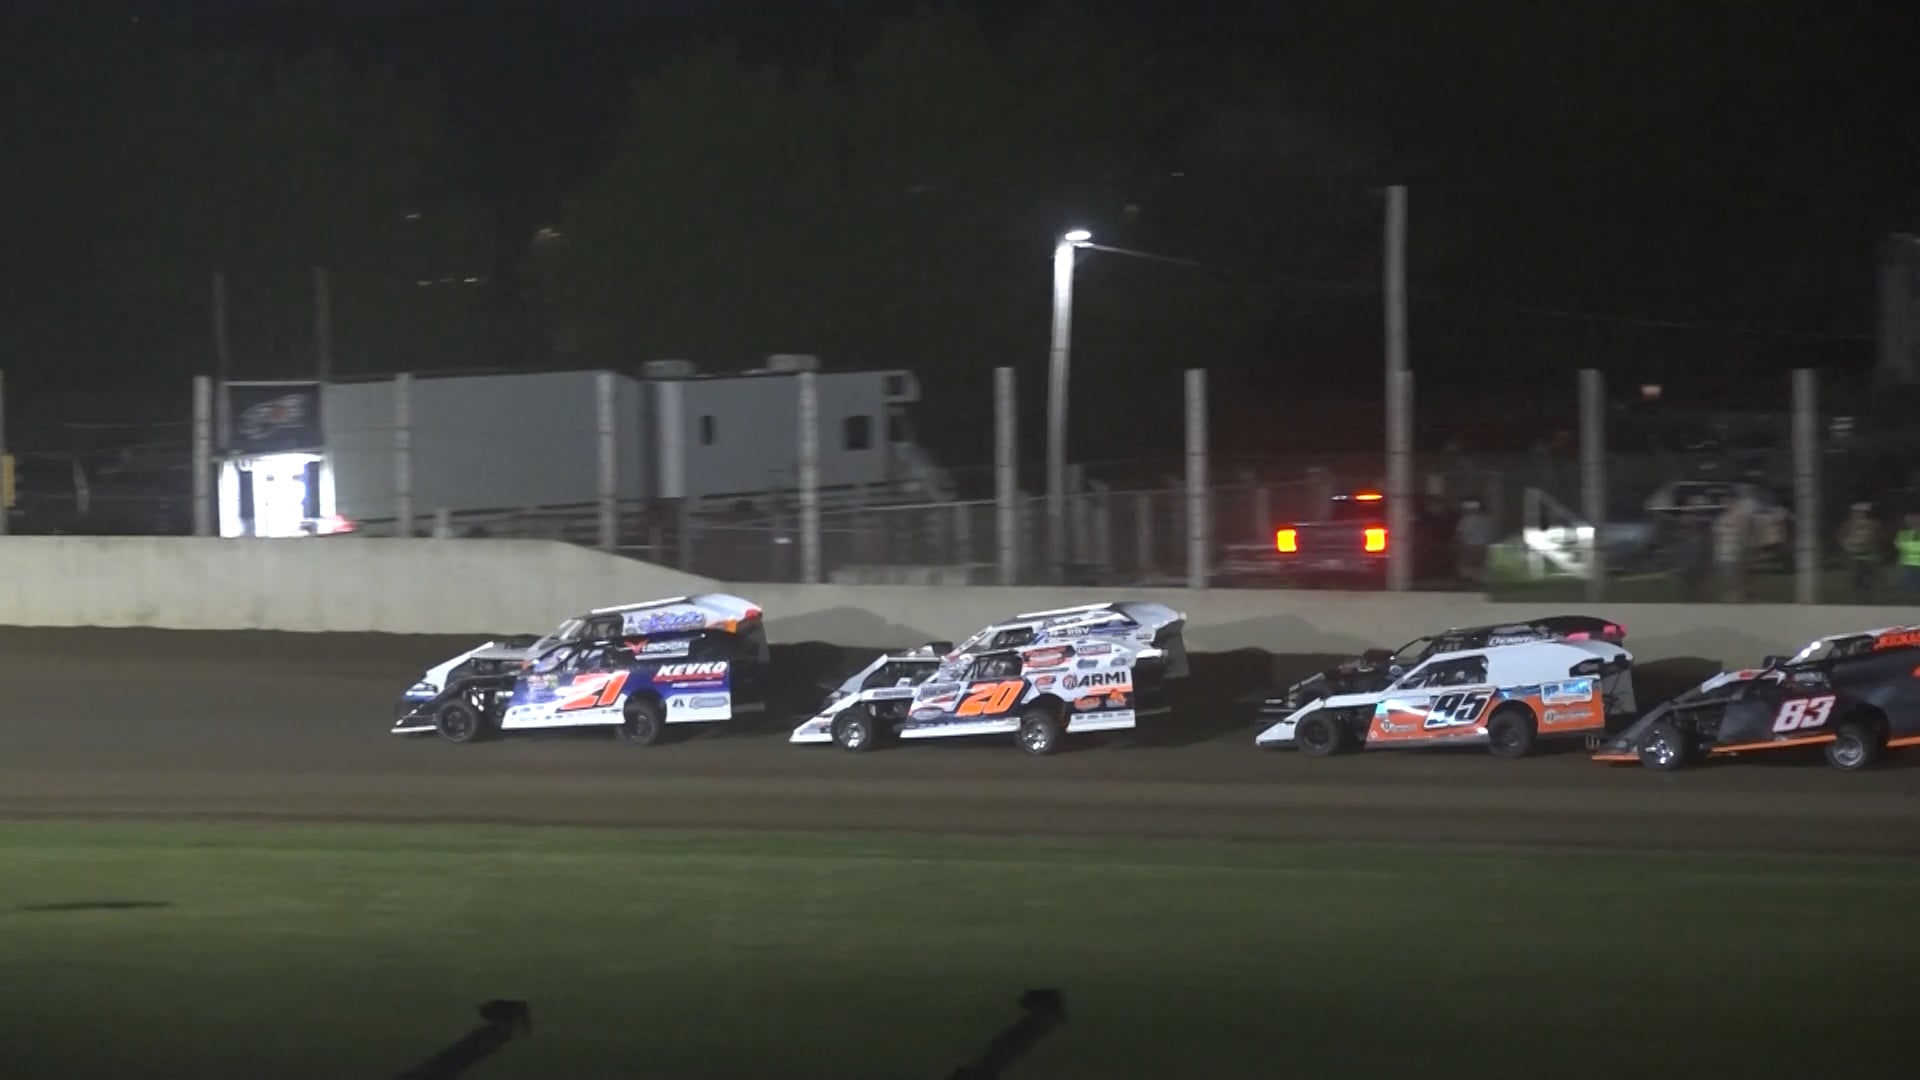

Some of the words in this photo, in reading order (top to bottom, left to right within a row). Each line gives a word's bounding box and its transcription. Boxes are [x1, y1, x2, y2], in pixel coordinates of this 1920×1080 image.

[656, 661, 728, 677] KEVKO
[1078, 671, 1127, 688] ARMI
[956, 681, 1025, 716] 20
[1425, 688, 1496, 729] 95
[1772, 695, 1836, 732] 83
